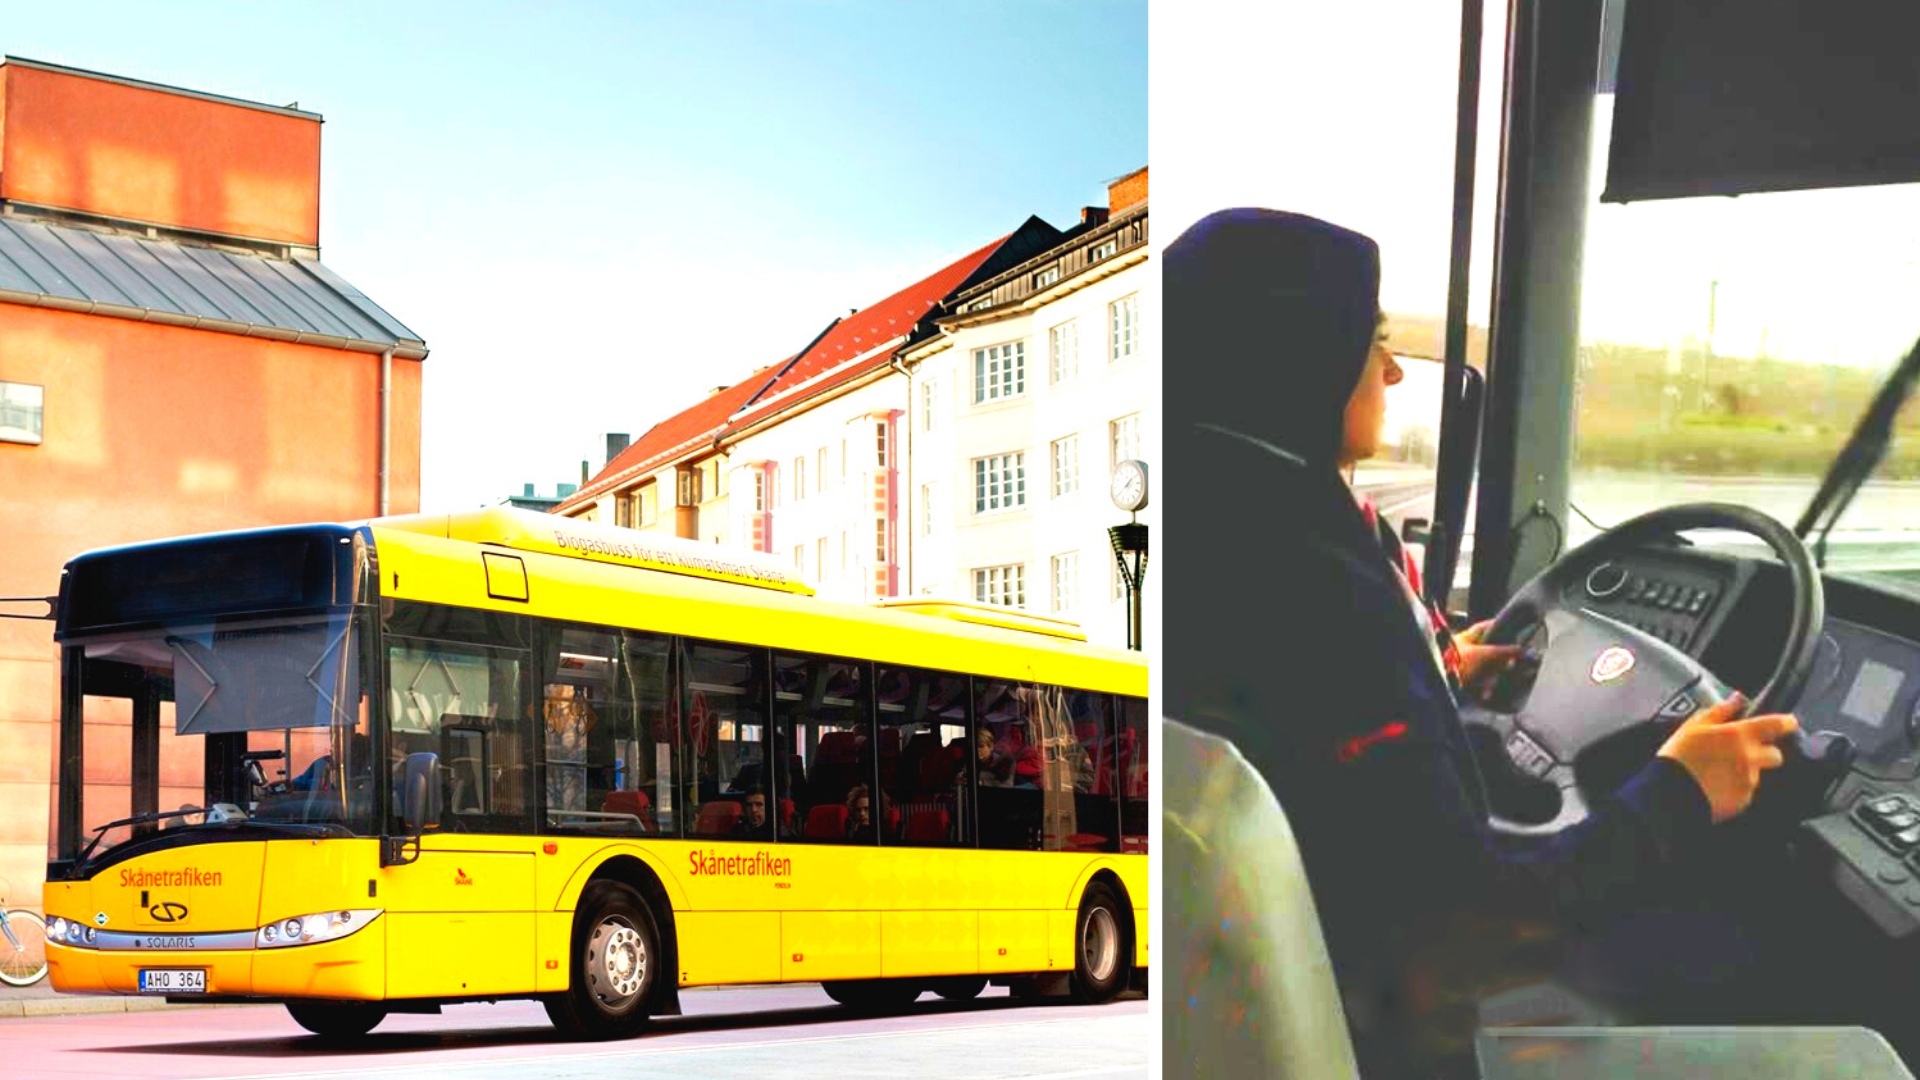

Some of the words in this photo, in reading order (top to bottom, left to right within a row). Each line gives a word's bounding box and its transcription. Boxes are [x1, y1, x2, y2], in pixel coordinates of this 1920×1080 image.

[554, 530, 632, 559] Biogasbuss
[690, 849, 791, 876] Skånetrafiken
[120, 867, 222, 887] Skånetrafiken
[147, 937, 195, 948] SOLARIS
[147, 972, 170, 987] AHO
[179, 972, 202, 987] 364
